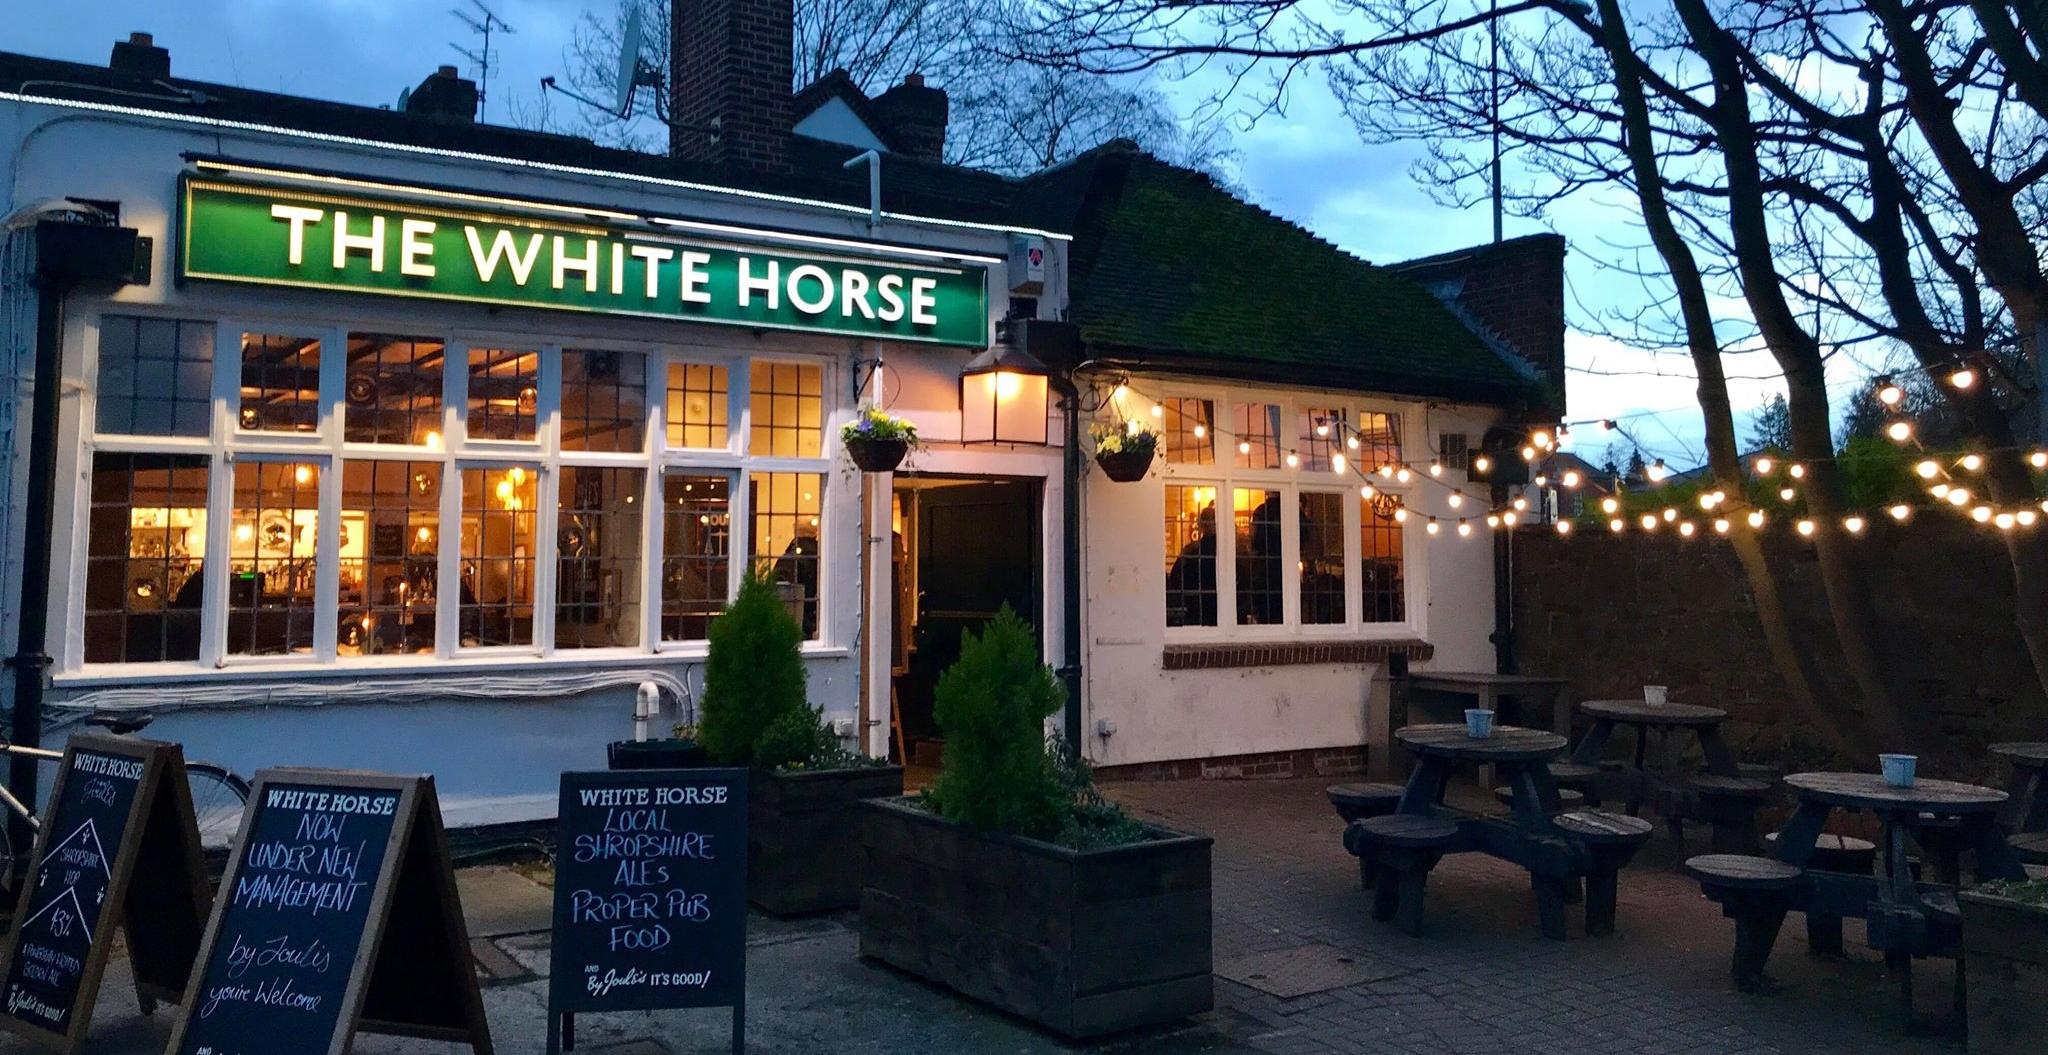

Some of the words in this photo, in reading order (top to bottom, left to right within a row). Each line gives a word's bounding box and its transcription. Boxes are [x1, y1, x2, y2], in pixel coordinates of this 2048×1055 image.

[269, 203, 437, 278] THE
[462, 226, 712, 305] WHITE
[736, 255, 939, 327] HORSE
[74, 752, 109, 775] WHITE
[106, 758, 145, 780] HORSE
[266, 789, 328, 812] WHITE
[328, 793, 396, 816] HORSE
[579, 788, 649, 807] WHITE
[655, 786, 728, 805] HORSE
[295, 812, 347, 843] NOW
[603, 807, 672, 833] LOCAL
[248, 840, 316, 875] UNDER
[317, 839, 367, 880] NEW
[574, 832, 716, 863] SHROPSHIRE
[233, 873, 368, 917] MANAGEMENT
[570, 889, 661, 924] PROPER
[607, 924, 671, 952] FOOD
[227, 933, 257, 979] by
[584, 965, 600, 973] AND
[254, 976, 322, 1013] Welcome
[587, 975, 604, 996] By
[650, 972, 670, 986] IT'S
[672, 970, 711, 989] GOOD!
